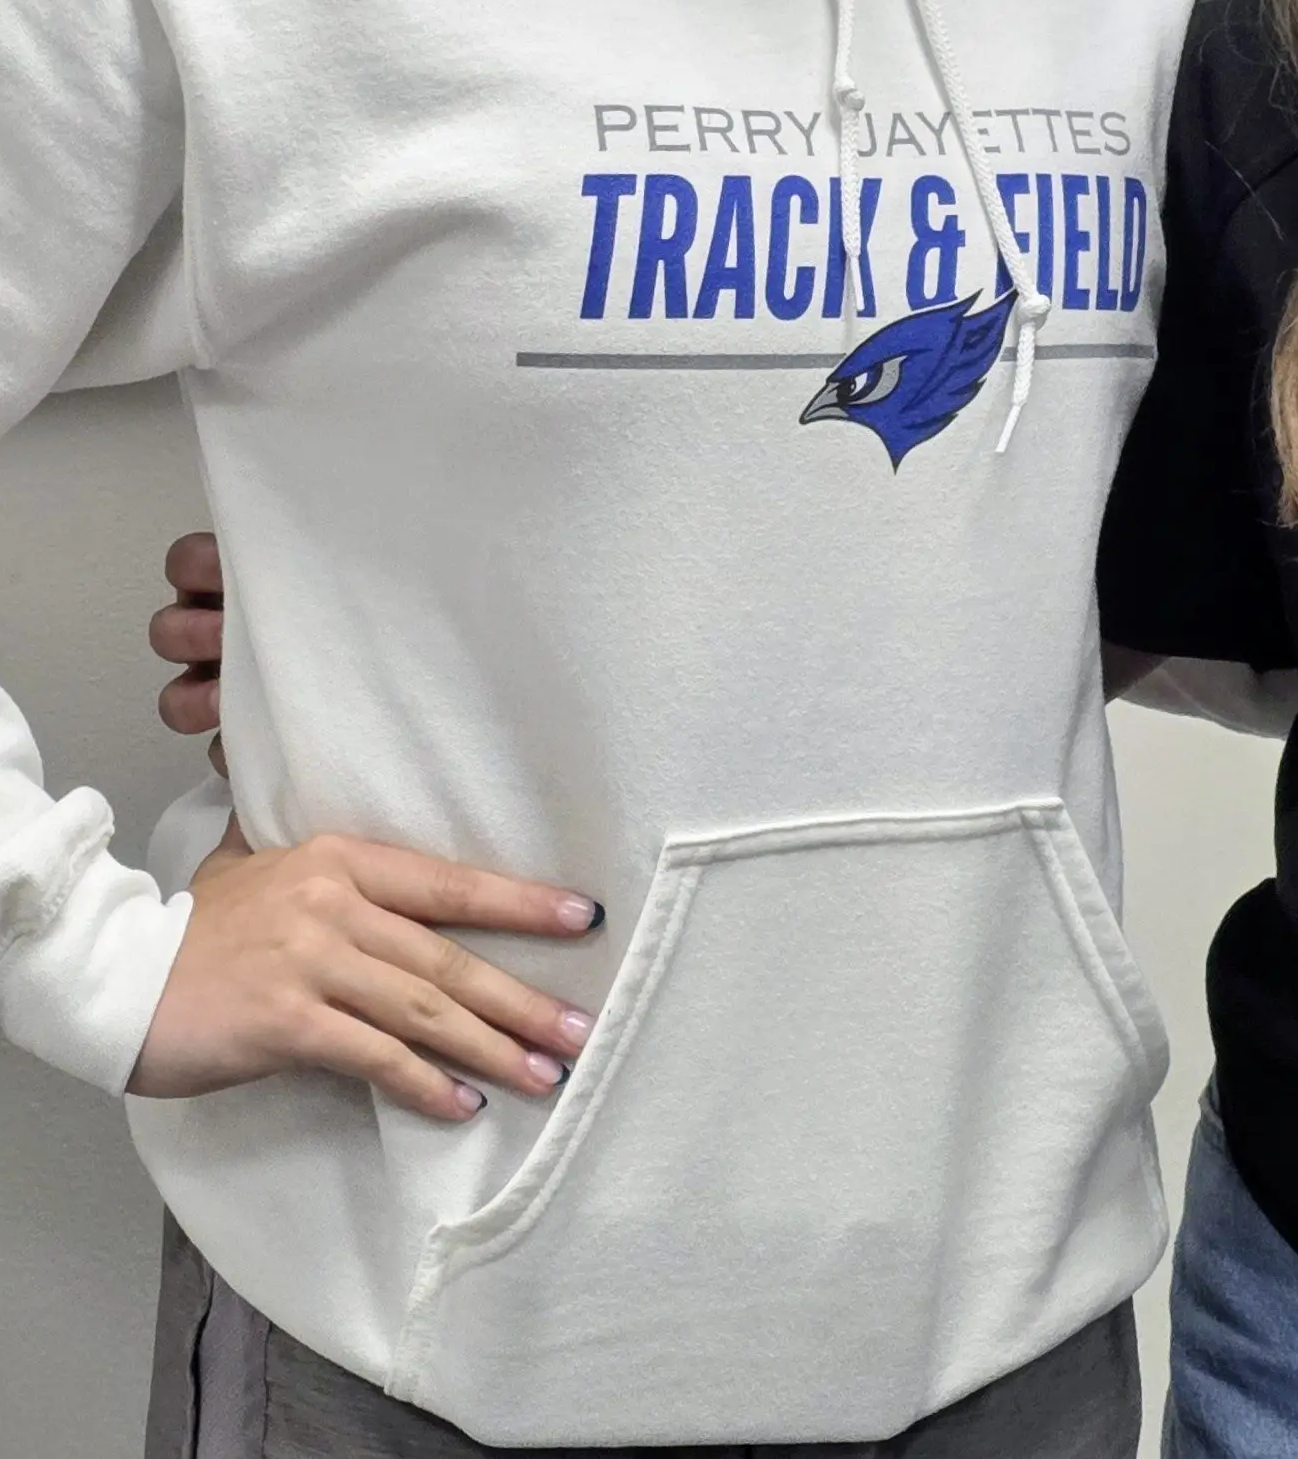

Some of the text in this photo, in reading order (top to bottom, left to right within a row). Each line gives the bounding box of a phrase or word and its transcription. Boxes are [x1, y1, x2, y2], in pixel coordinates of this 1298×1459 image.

[593, 104, 822, 157] PERRY
[579, 173, 883, 321] TRACK
[905, 174, 966, 312] &
